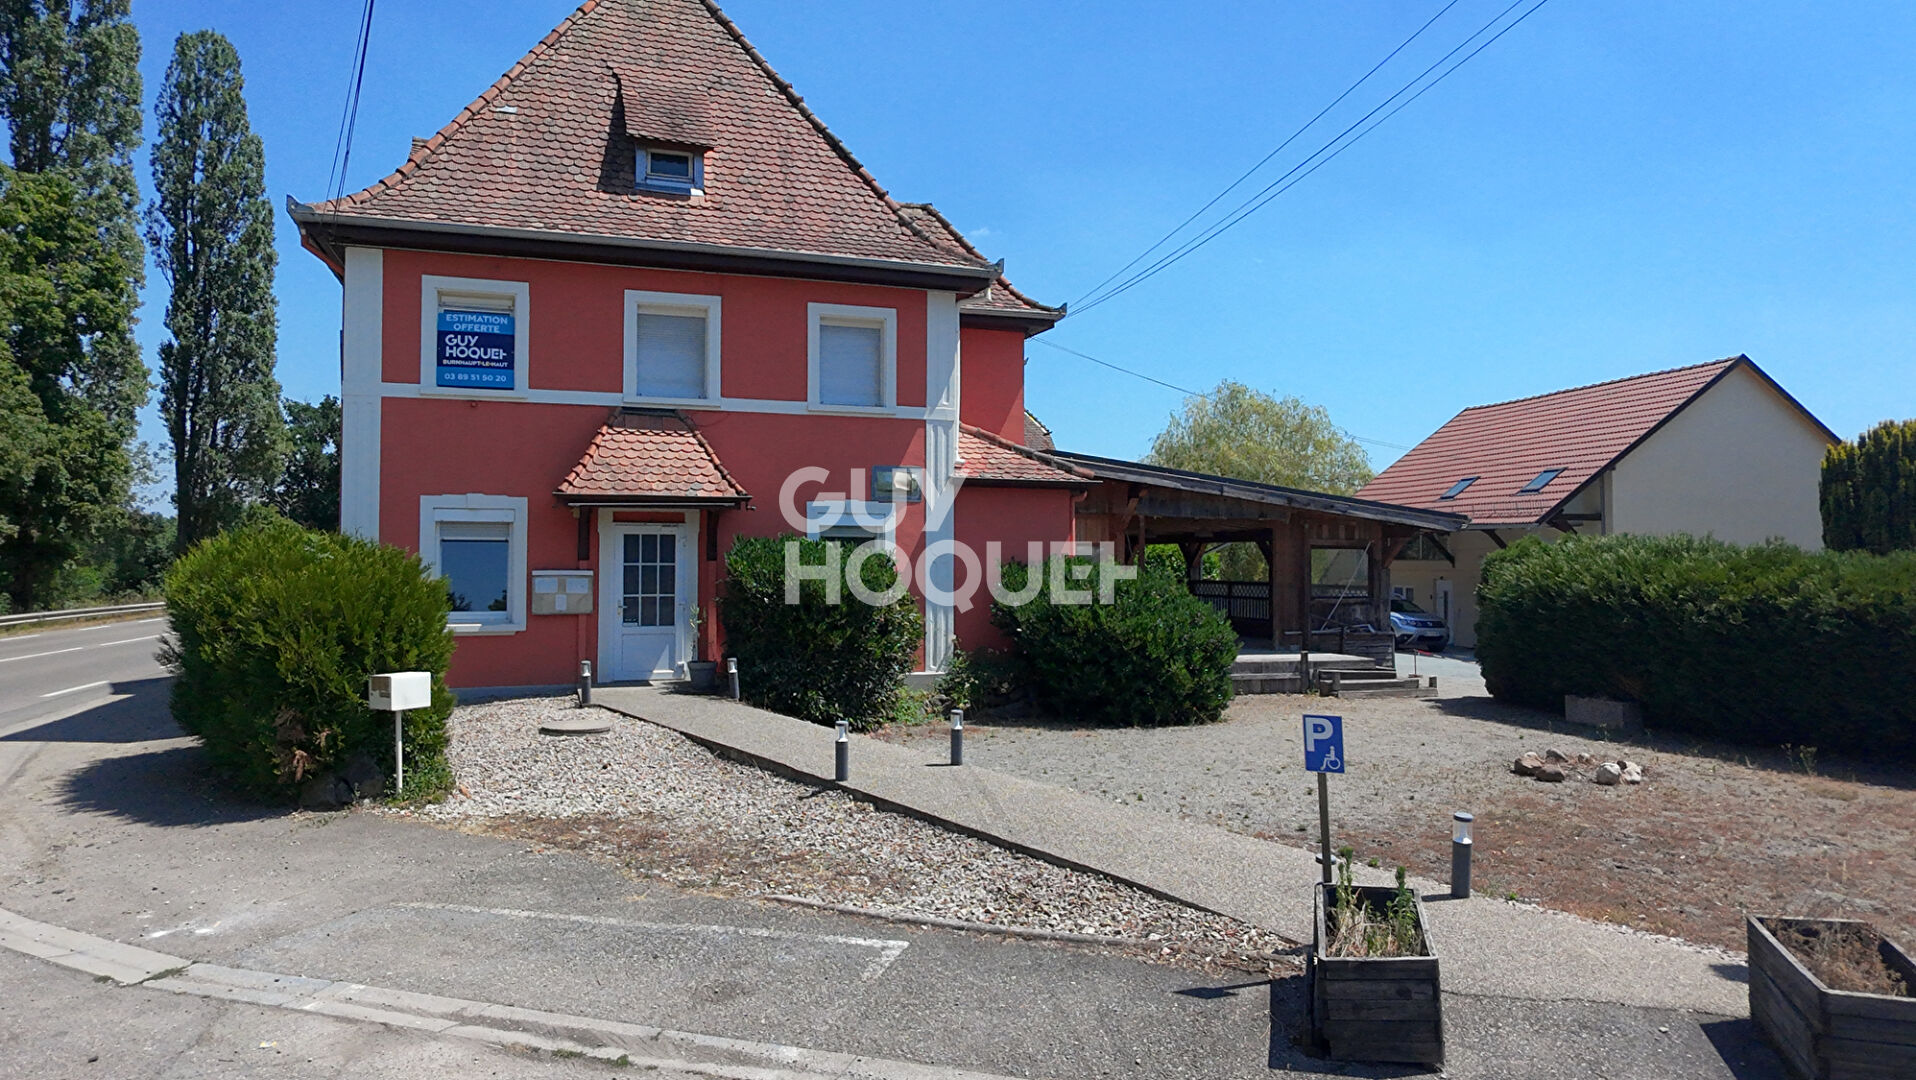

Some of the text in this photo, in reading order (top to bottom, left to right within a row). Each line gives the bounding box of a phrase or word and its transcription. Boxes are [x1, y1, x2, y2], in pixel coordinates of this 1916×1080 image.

[446, 314, 508, 324] ESTIMATION
[453, 323, 501, 333] OFFERTE
[445, 334, 479, 346] GUY
[445, 346, 507, 360] HOQUET
[1305, 717, 1333, 752] P
